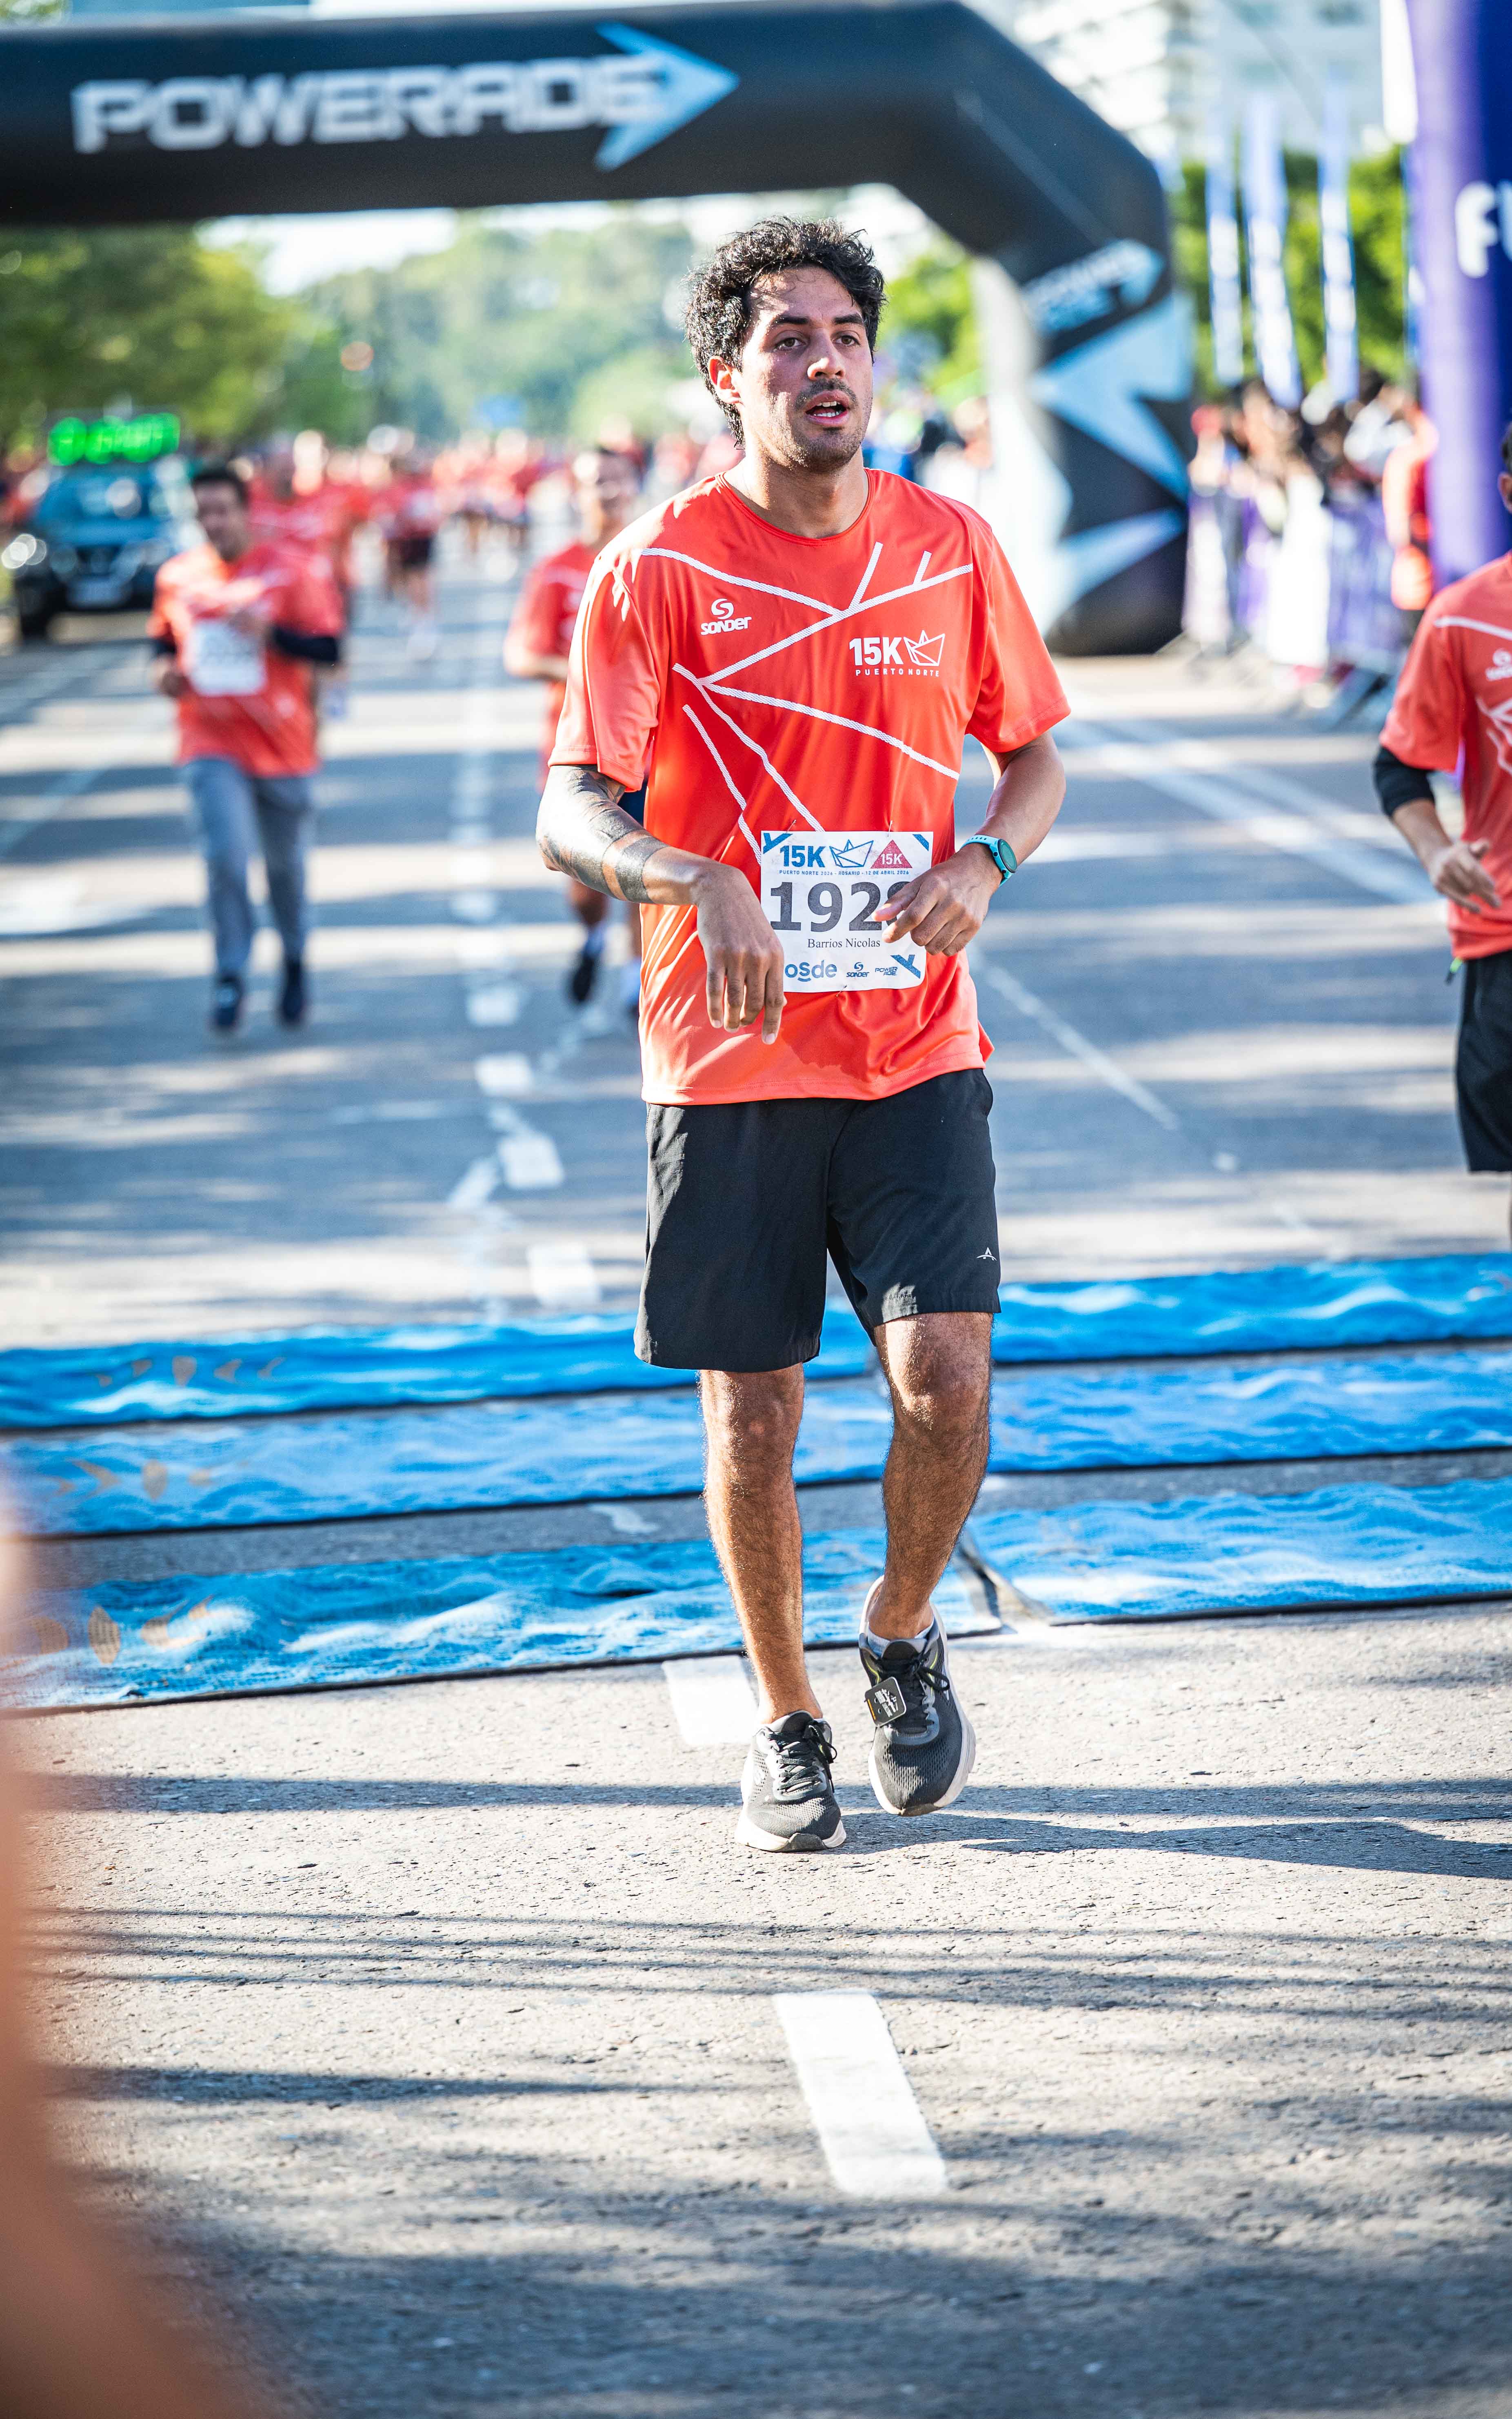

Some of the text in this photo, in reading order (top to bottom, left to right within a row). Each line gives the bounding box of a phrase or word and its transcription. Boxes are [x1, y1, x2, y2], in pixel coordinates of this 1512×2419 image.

[71, 54, 669, 154] POWERADE
[849, 637, 904, 666] 15K
[855, 668, 939, 677] PUERTO NORTE
[780, 845, 826, 868] 15K
[880, 853, 903, 865] 15K
[770, 881, 910, 932] 192
[808, 938, 881, 948] Barrios Nicolas
[784, 960, 837, 980] osde
